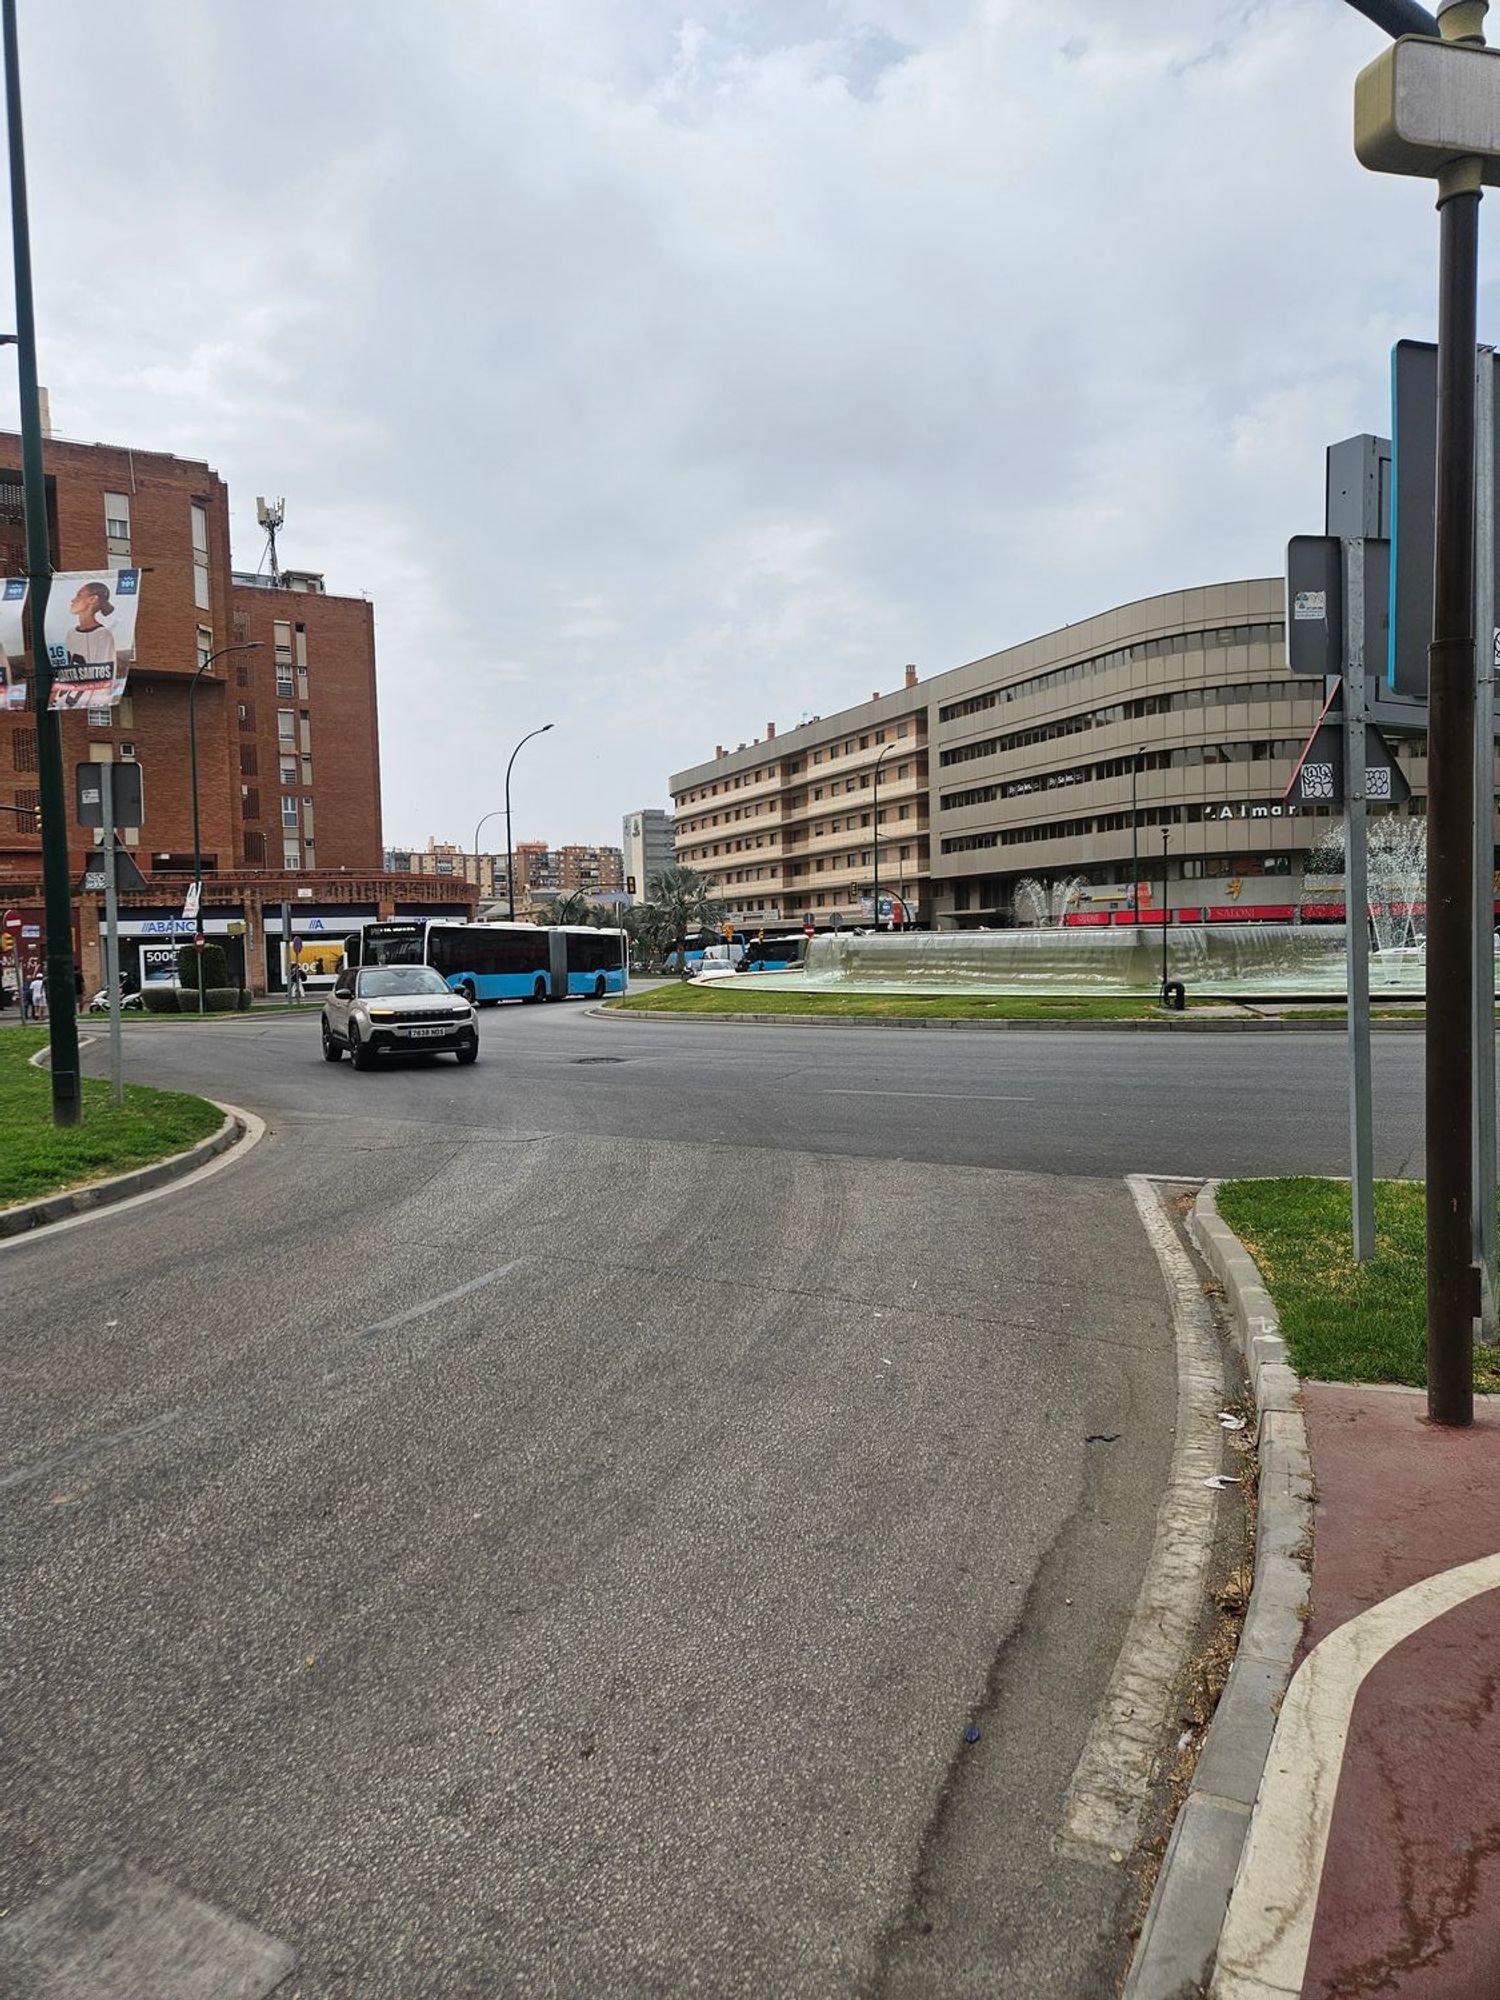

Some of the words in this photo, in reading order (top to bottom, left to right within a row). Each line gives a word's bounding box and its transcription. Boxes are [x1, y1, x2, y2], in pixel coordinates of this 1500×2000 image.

[50, 646, 64, 658] 16
[79, 665, 112, 680] SANTOS
[1220, 804, 1296, 819] Almar
[147, 921, 198, 932] ABANC
